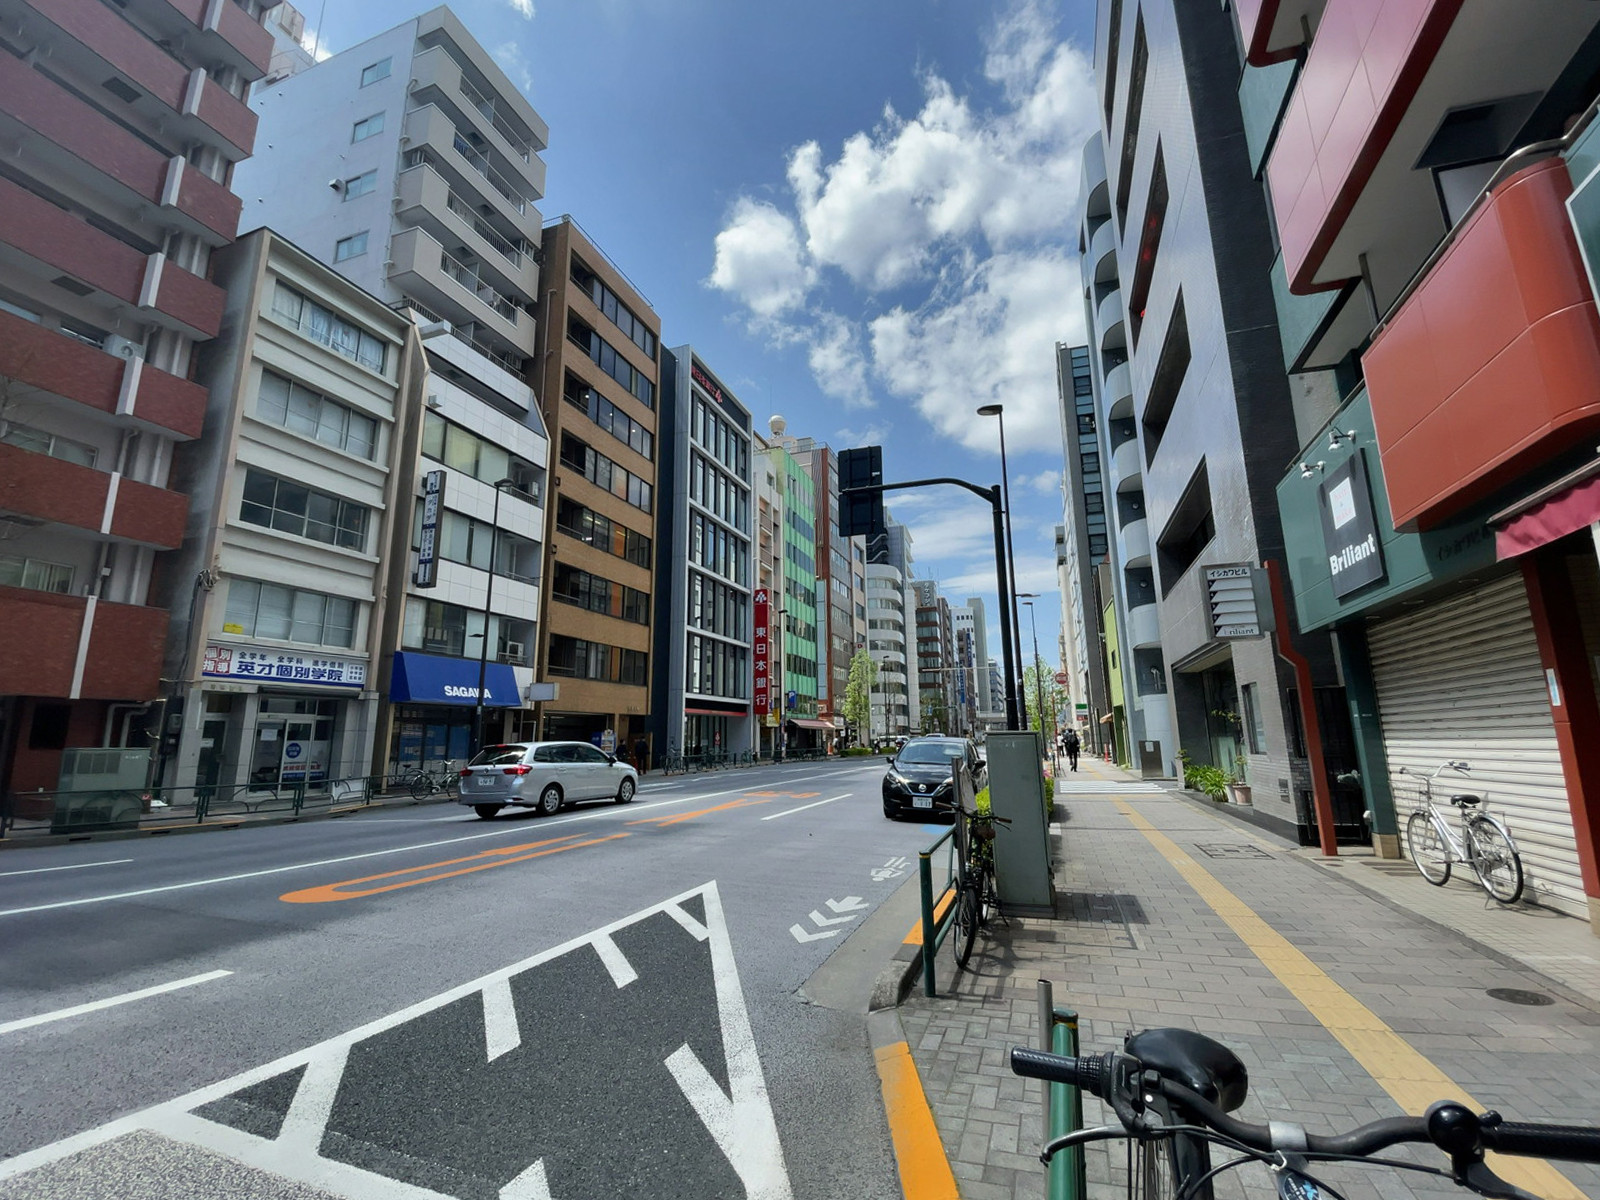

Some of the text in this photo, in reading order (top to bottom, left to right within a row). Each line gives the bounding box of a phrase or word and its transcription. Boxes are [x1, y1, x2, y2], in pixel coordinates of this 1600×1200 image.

[1329, 533, 1376, 576] Briliant
[1210, 568, 1248, 578] イシカワビル
[238, 651, 267, 661] 全学年
[277, 655, 304, 665] 全学科
[755, 626, 767, 706] 東日本銀行
[236, 660, 343, 682] 英才個別学院
